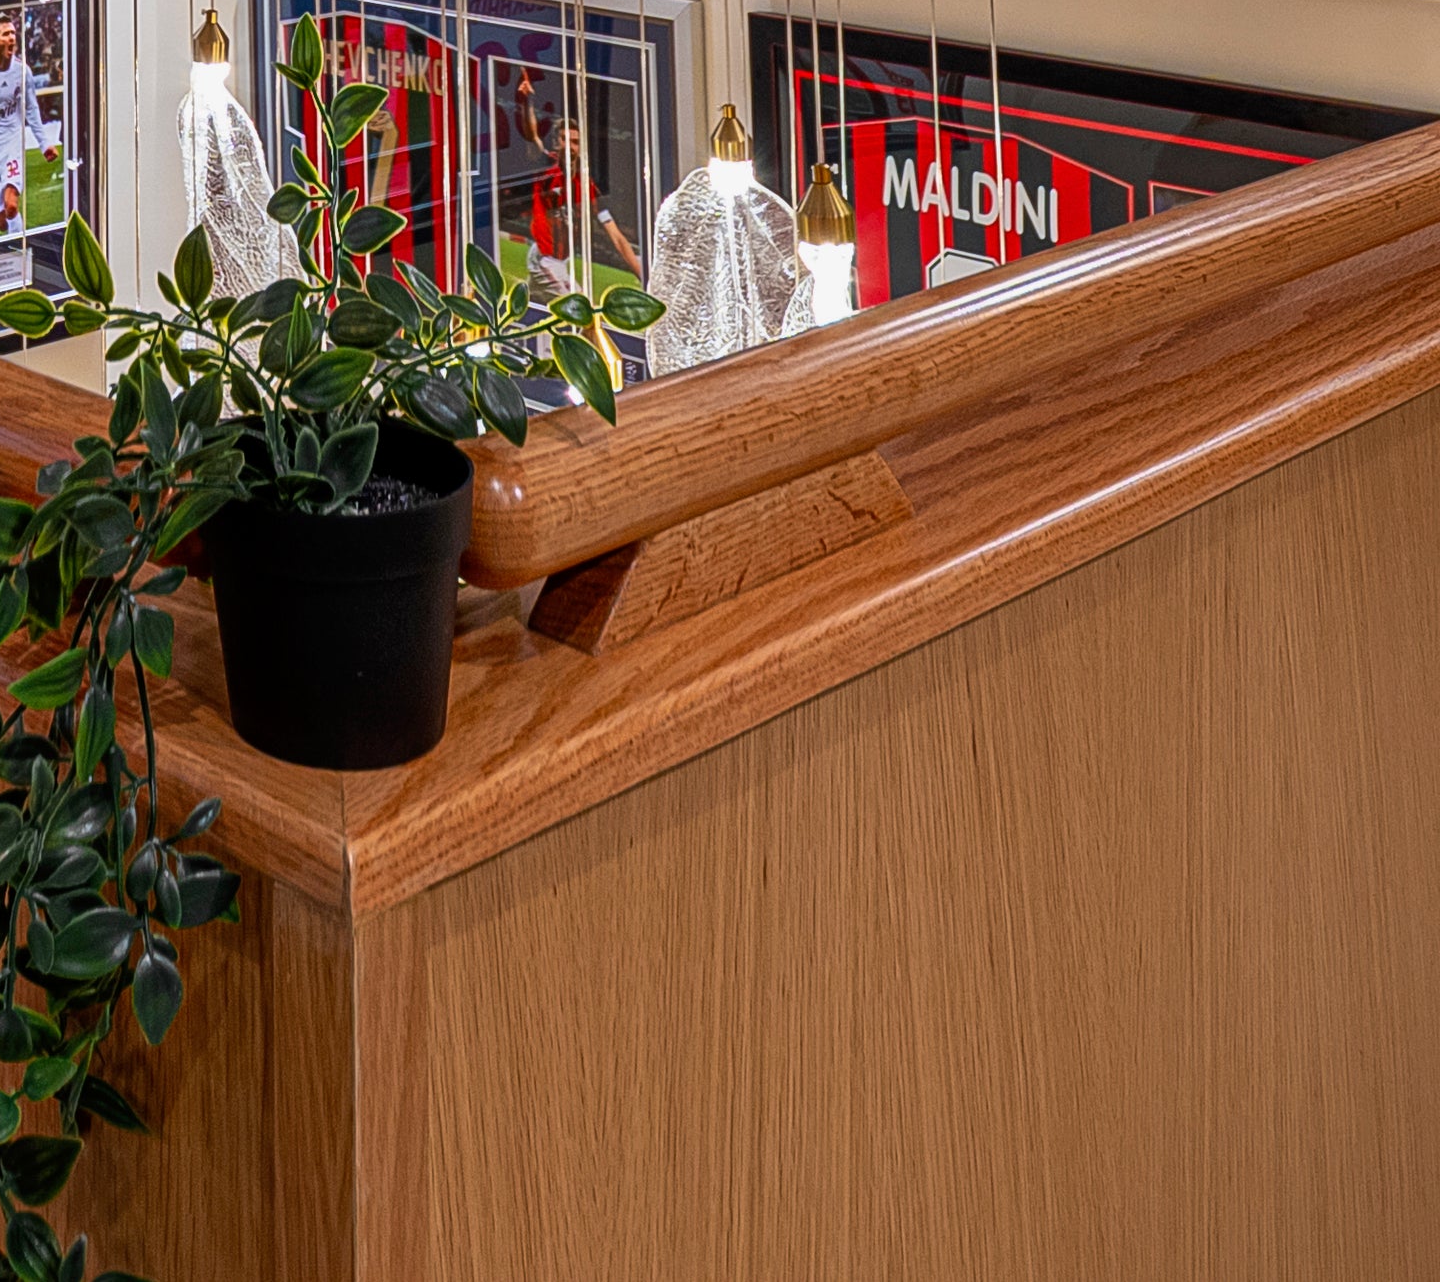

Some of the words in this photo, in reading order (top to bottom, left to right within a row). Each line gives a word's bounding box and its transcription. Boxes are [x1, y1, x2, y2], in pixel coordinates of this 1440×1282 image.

[323, 38, 444, 97] HEVCHENKO
[6, 159, 20, 178] 32
[883, 155, 1059, 243] MALDINI
